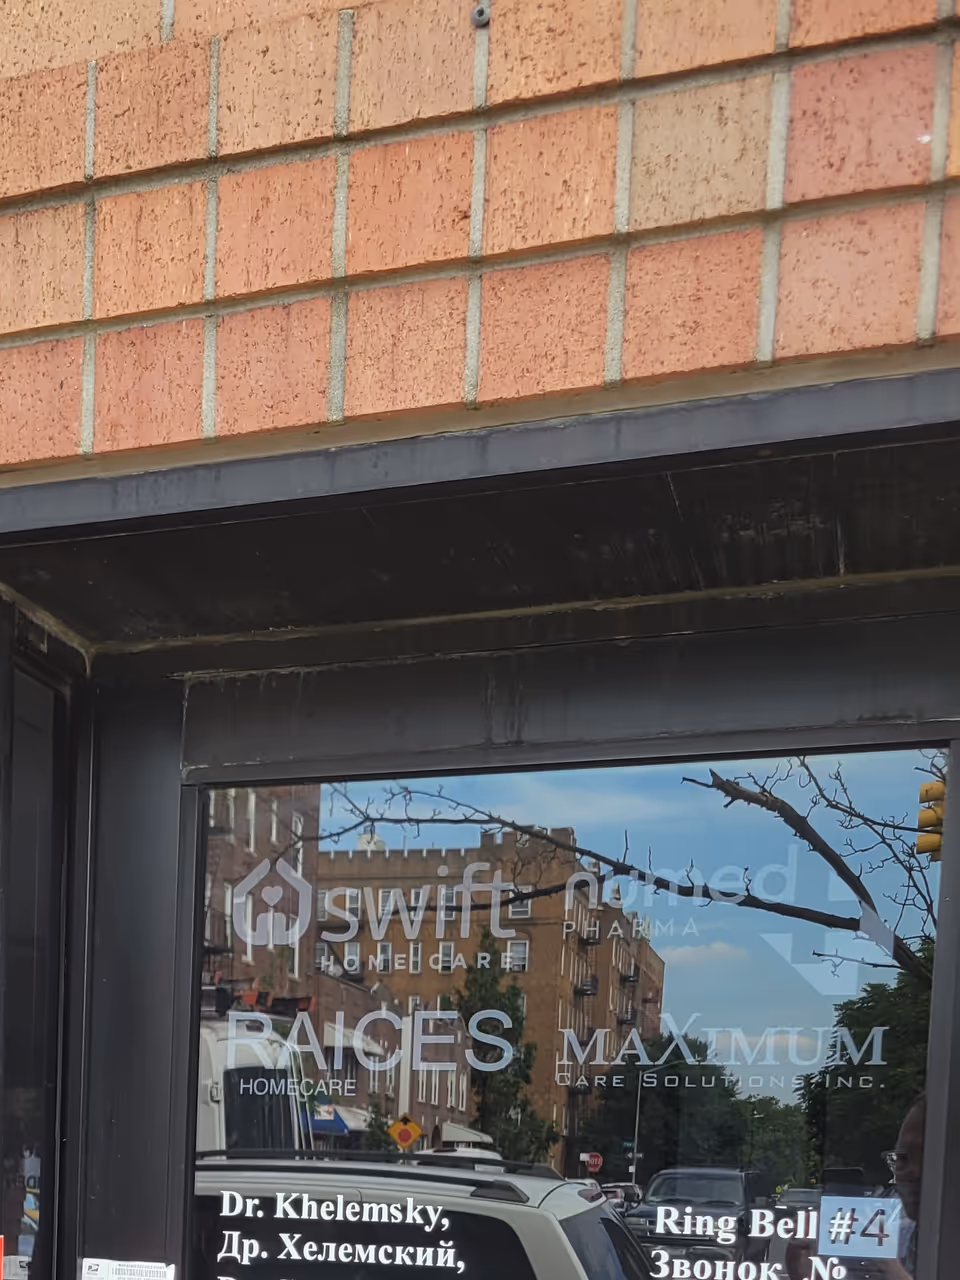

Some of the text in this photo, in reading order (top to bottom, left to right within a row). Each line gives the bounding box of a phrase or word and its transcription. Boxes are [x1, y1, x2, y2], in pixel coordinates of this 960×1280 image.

[321, 862, 517, 942] swift
[562, 916, 700, 940] PHARMA
[320, 952, 515, 971] HOME CARE
[226, 1009, 514, 1073] RAICES
[556, 1012, 890, 1066] MAXIMUM
[239, 1077, 357, 1097] HOMECARE
[219, 1190, 450, 1232] Dr. Khelemsky,
[655, 1206, 736, 1245] Ring
[749, 1208, 818, 1240] Bell
[217, 1230, 466, 1274] Др. Хелемский,
